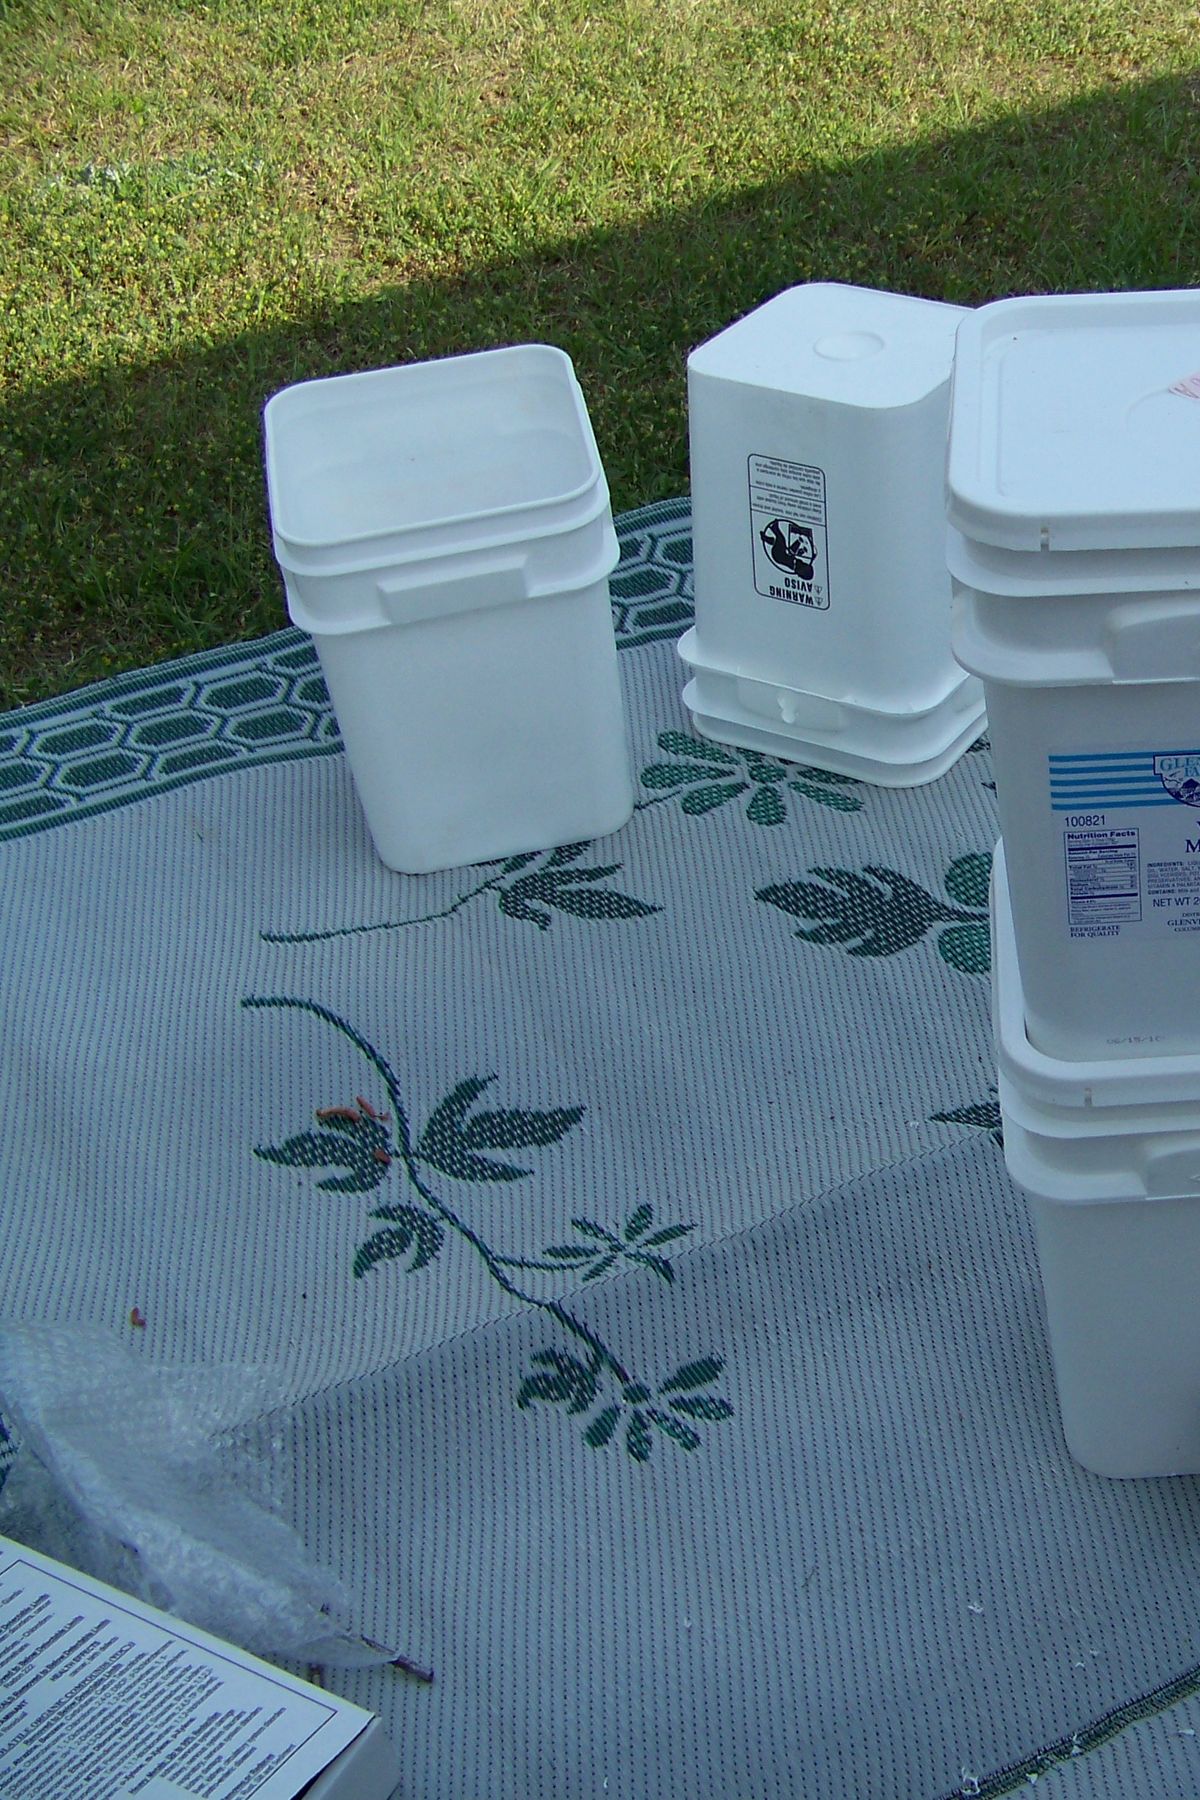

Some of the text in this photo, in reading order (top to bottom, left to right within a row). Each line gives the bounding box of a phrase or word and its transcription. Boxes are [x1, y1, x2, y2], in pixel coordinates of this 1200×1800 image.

[784, 577, 813, 592] AVISO
[769, 585, 814, 605] WARNING
[1063, 814, 1106, 827] 100821
[1066, 829, 1136, 840] Nutrition Facts
[1151, 897, 1172, 908] NET
[1173, 896, 1191, 907] WT
